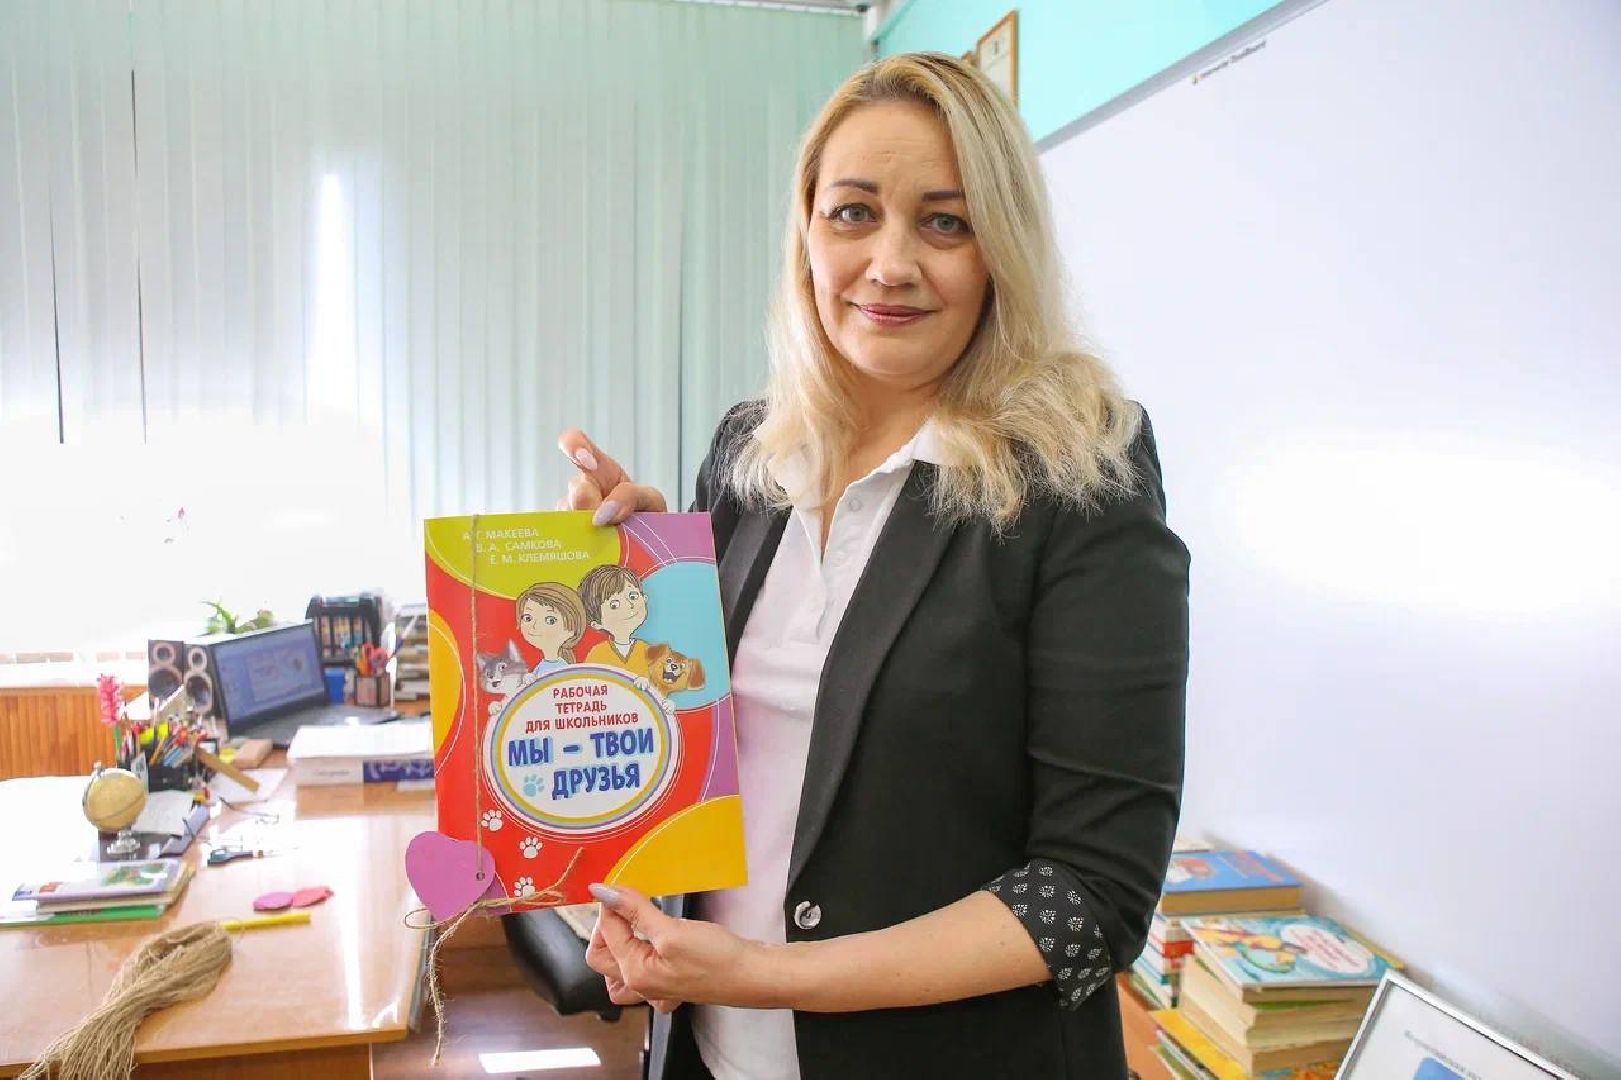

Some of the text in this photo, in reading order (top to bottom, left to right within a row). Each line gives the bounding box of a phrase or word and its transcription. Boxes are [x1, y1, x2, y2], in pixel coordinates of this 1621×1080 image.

[553, 684, 608, 699] РАБОЧАЯ
[555, 700, 607, 714] ТЕТРАДЬ
[525, 712, 639, 734] ДЛЯ ШКОЛЬНИКОВ
[508, 737, 549, 767] МЫ
[590, 728, 654, 758] ТВОИ
[552, 763, 640, 800] ДРУЗЬЯ
